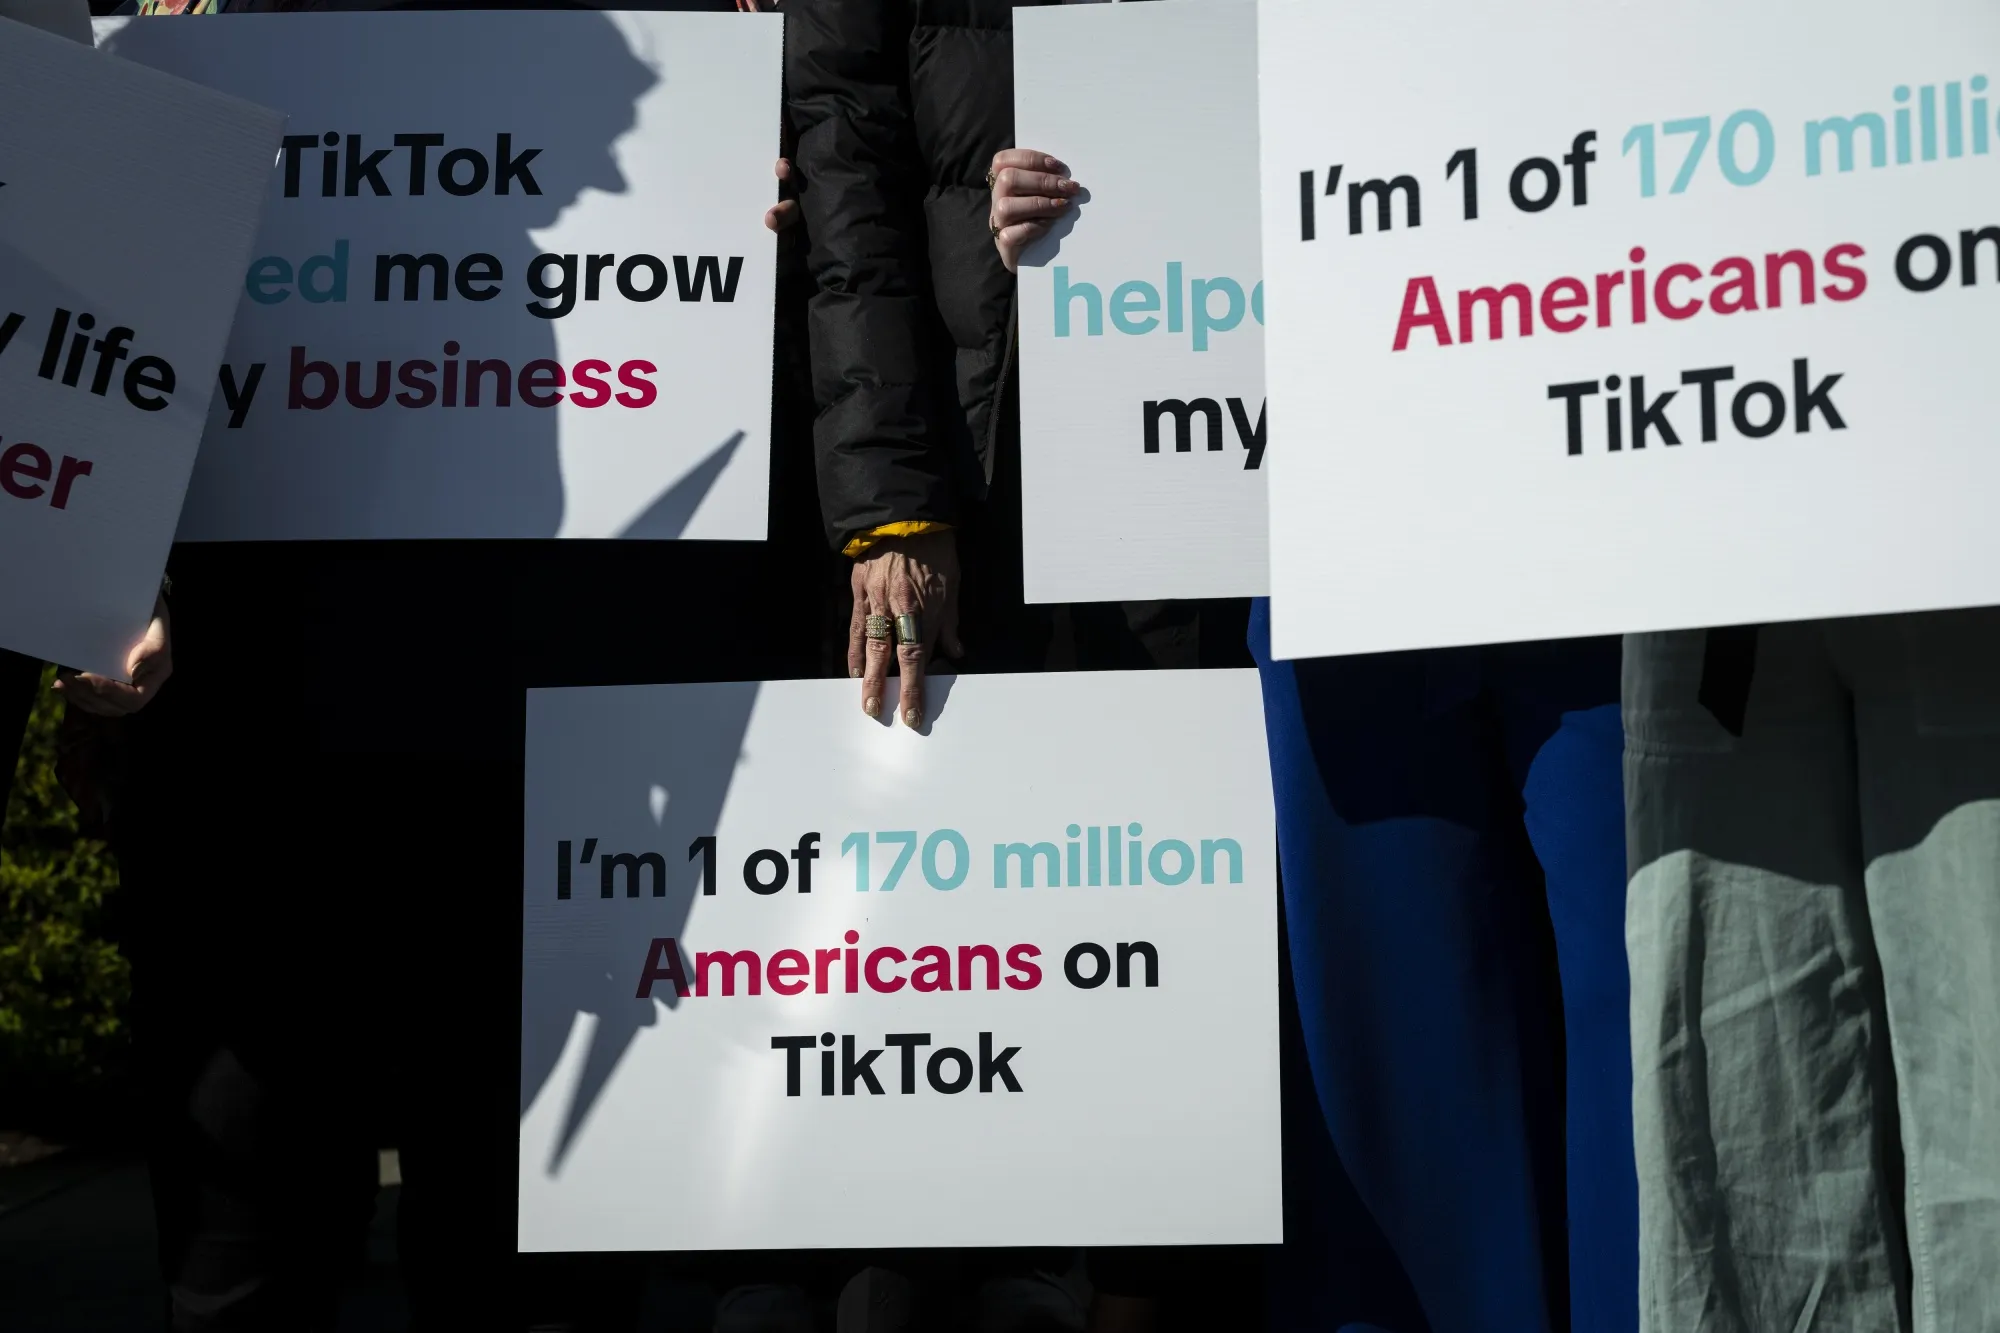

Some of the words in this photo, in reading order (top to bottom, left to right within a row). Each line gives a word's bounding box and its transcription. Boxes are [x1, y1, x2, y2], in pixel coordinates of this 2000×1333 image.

[281, 131, 544, 198] TikTok
[1300, 165, 1421, 242] I’m
[1446, 148, 1478, 221] 1
[1508, 131, 1597, 213] of
[1623, 110, 1774, 197] 170
[1805, 75, 2000, 176] milli
[245, 239, 349, 305] ed
[374, 252, 504, 303] me
[526, 252, 744, 320] grow
[1392, 247, 1868, 352] Americans
[1894, 225, 2000, 293] on
[37, 307, 176, 411] life
[218, 362, 267, 429] y
[288, 341, 657, 411] business
[1143, 397, 1267, 470] my
[1547, 357, 1848, 456] TikTok
[0, 436, 93, 510] er
[557, 838, 666, 900] I’m
[688, 836, 717, 896] 1
[743, 832, 820, 895] of
[841, 829, 969, 891] 170
[993, 822, 1243, 888] million
[635, 930, 1042, 999] Americans
[1063, 940, 1159, 989] on
[771, 1032, 1024, 1097] TikTok
